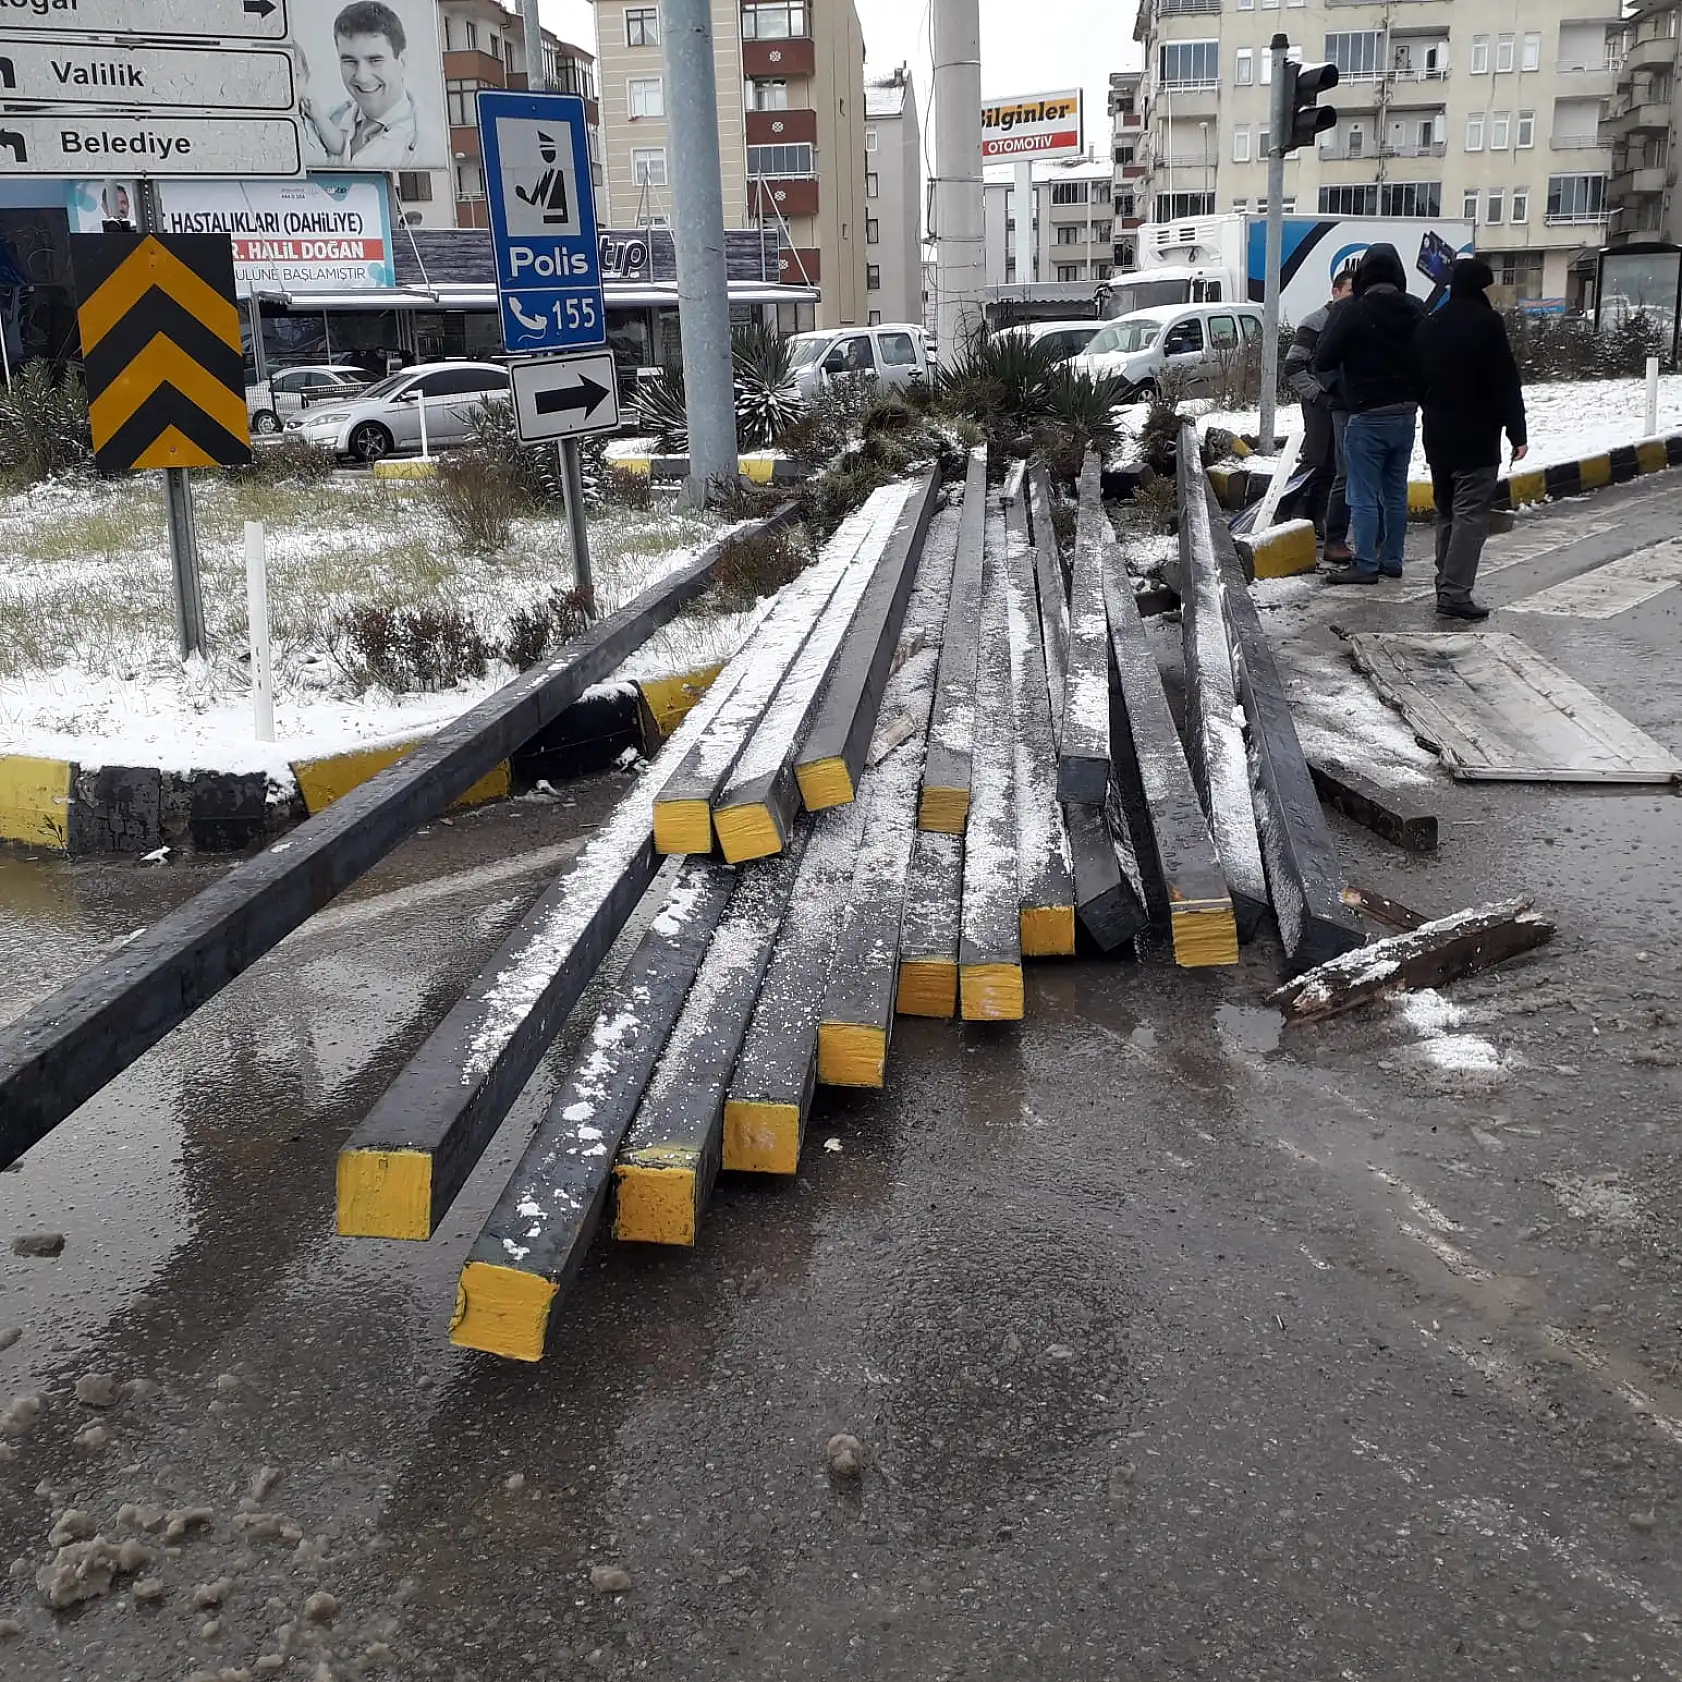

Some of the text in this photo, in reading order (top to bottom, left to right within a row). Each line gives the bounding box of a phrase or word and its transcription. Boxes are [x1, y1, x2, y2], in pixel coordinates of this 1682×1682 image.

[51, 60, 146, 87] Valilik
[61, 131, 191, 159] Belediye
[171, 212, 280, 233] HASTALIKLARI
[248, 241, 298, 259] HALİL
[302, 240, 364, 259] DOĞAN
[509, 246, 588, 277] Polis
[235, 266, 366, 283] ULÜNE BAŞLAMIŞTIR
[552, 298, 595, 330] 155
